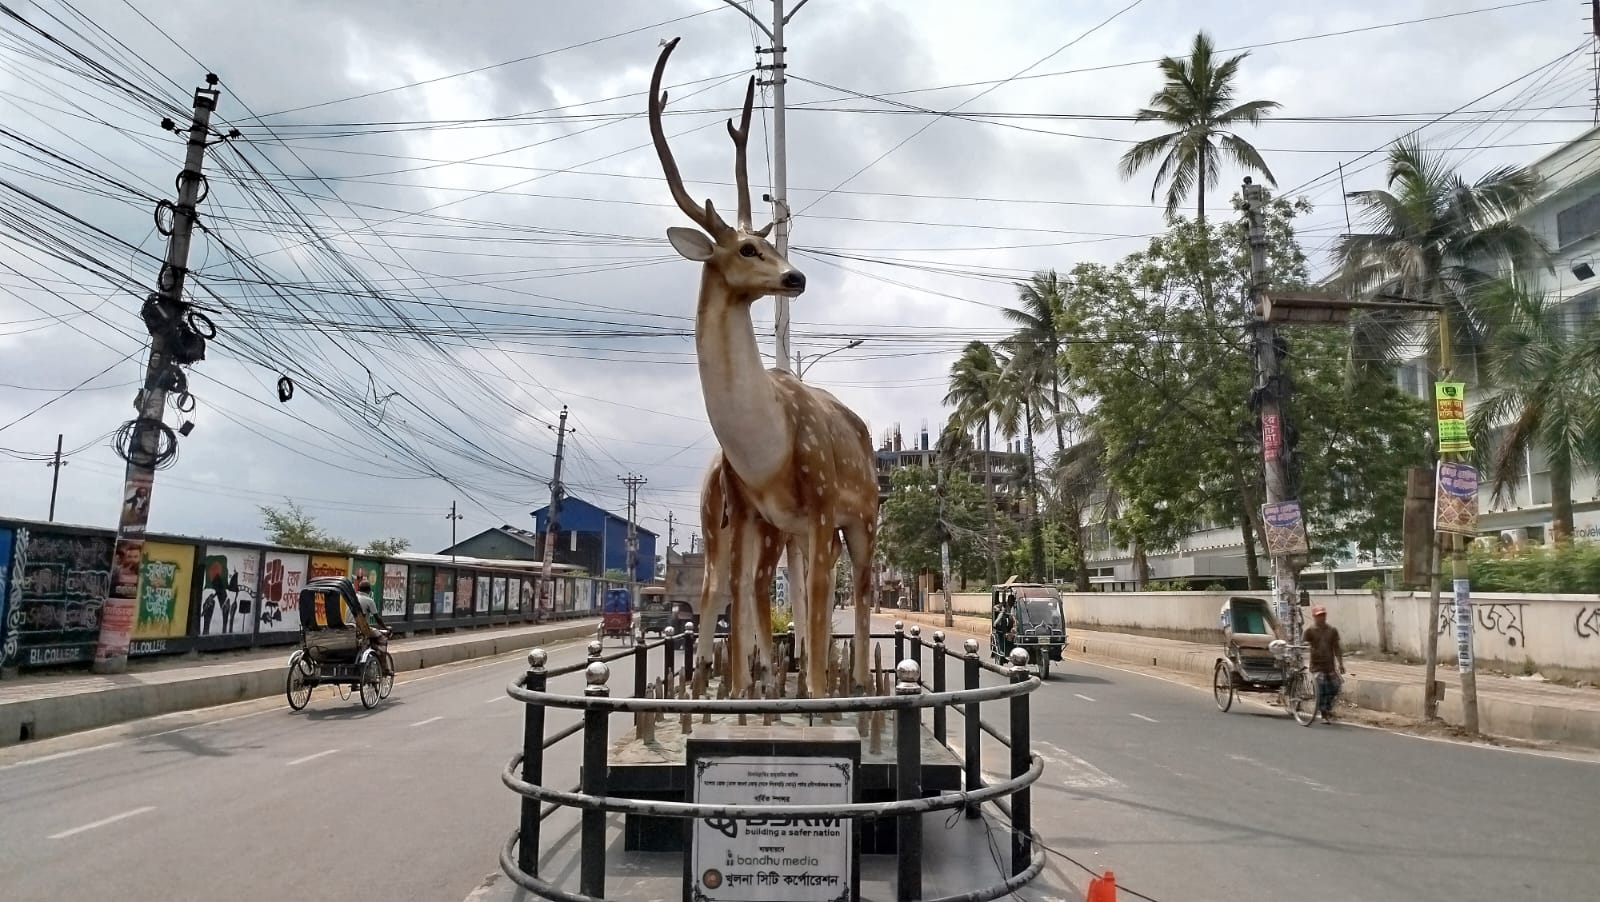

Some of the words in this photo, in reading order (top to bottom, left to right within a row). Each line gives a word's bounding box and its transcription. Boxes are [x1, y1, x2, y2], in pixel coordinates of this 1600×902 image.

[745, 828, 779, 837] building
[789, 828, 812, 836] safer
[737, 854, 780, 866] bandhu
[782, 855, 819, 867] media
[725, 873, 754, 887] খুলনা
[757, 871, 780, 886] সিটি
[783, 870, 838, 887] কর্পোরেশন
